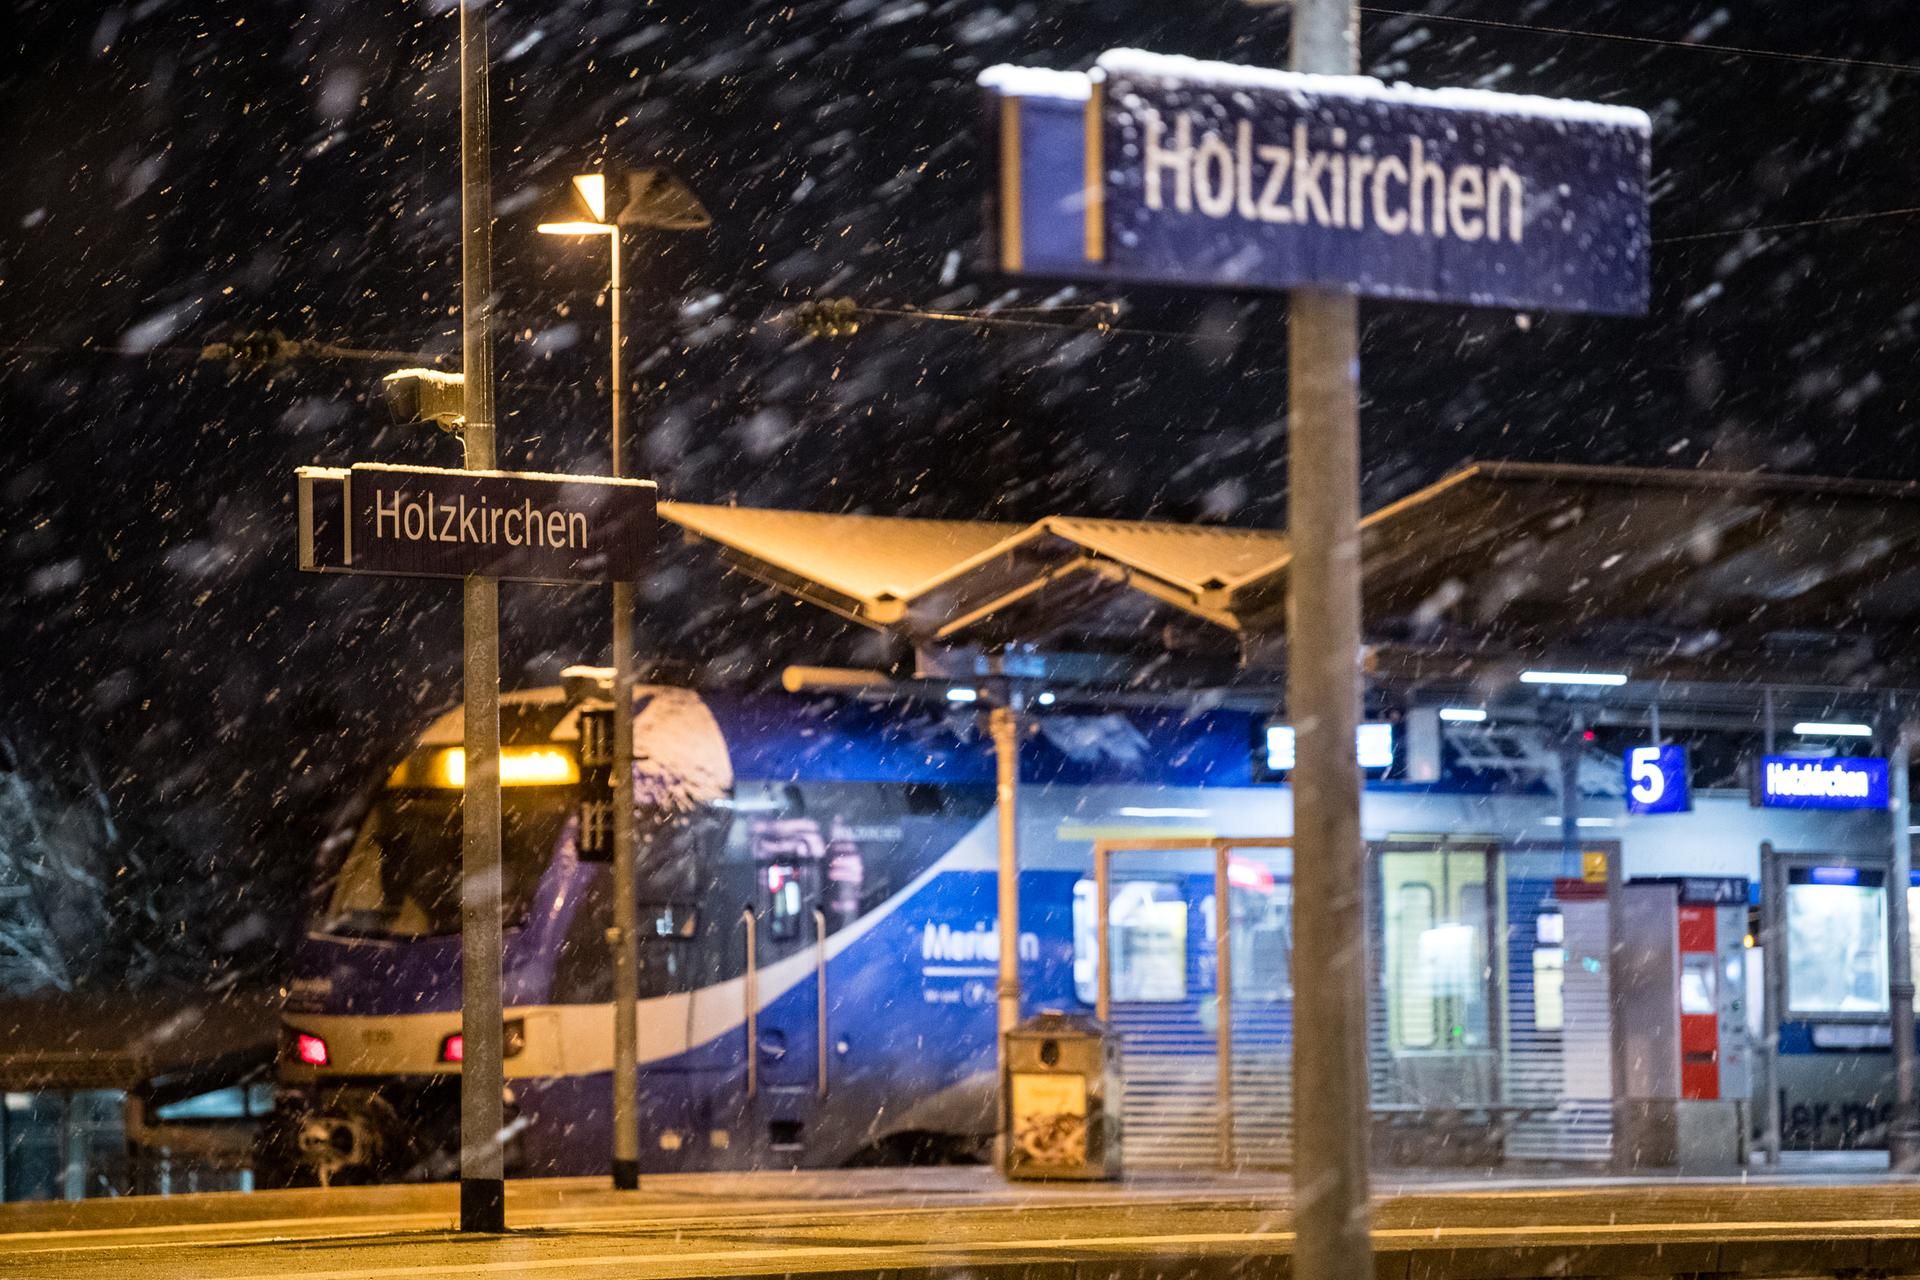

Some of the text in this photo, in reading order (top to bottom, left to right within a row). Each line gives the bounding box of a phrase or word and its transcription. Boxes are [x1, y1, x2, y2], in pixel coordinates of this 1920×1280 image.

[1144, 109, 1523, 243] Holzkirchen
[375, 488, 588, 549] Holzkirchen
[1630, 746, 1666, 804] 5
